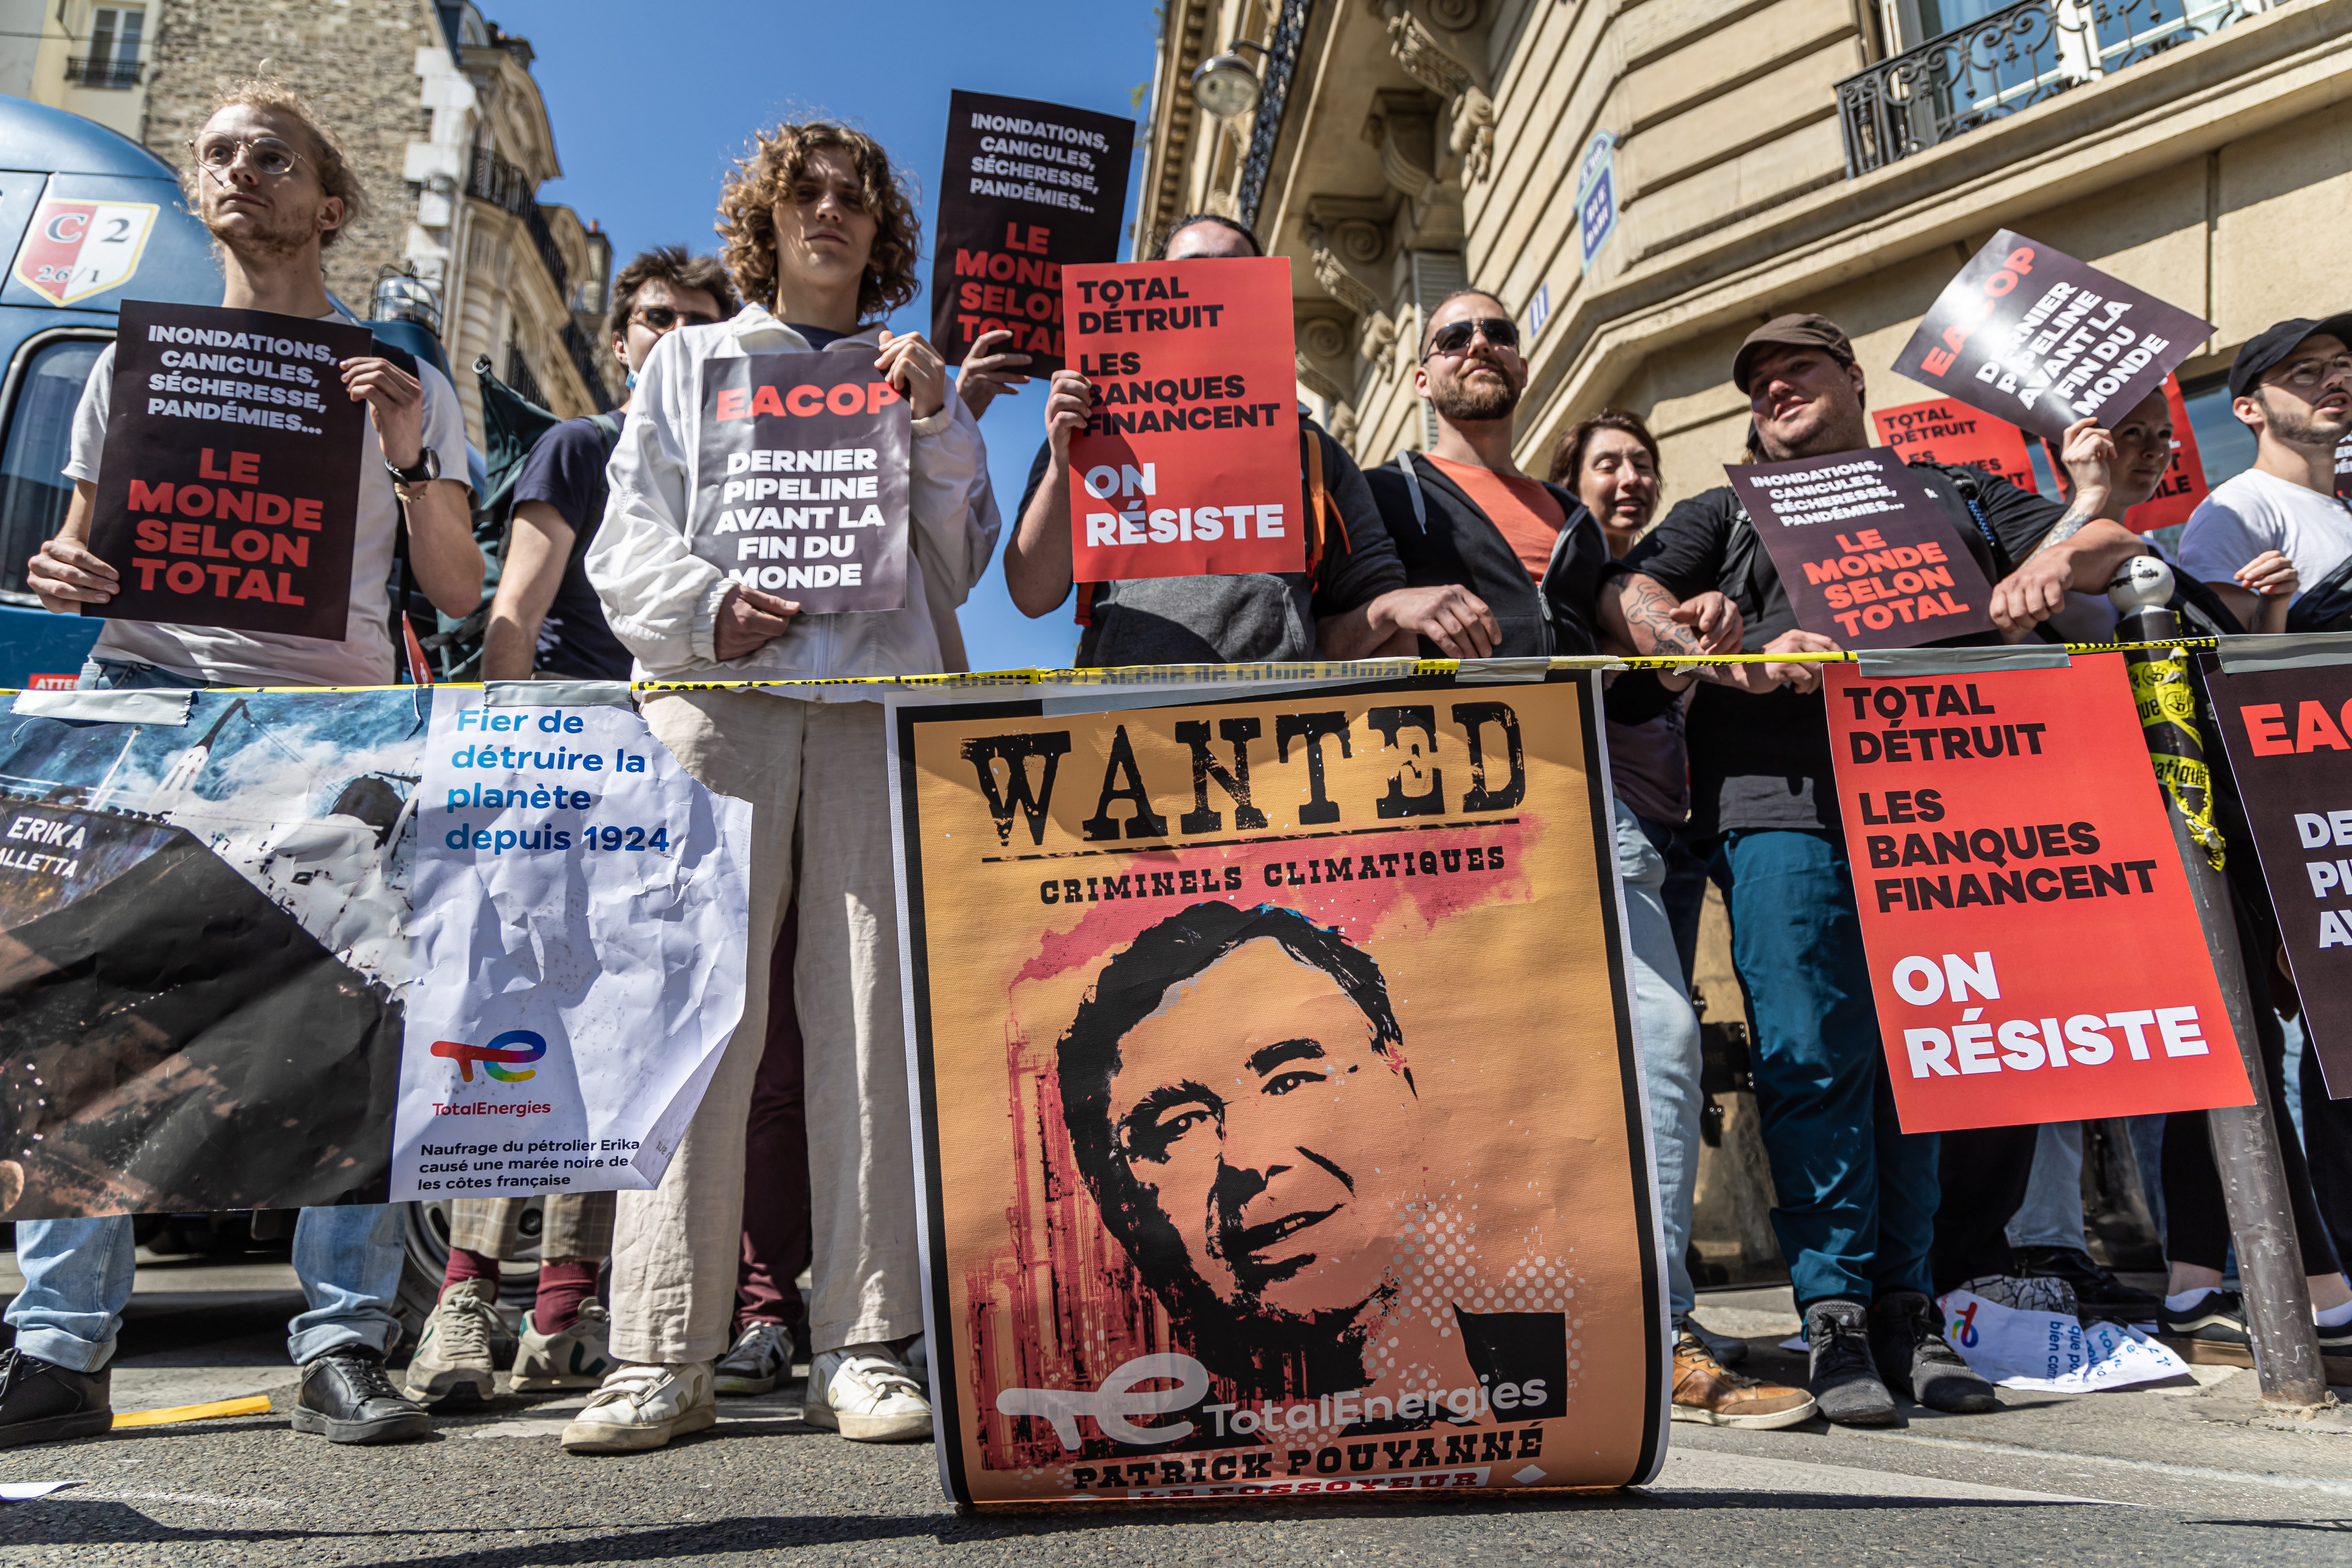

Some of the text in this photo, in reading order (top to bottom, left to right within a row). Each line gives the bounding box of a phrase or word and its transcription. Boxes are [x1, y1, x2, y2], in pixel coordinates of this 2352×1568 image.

[971, 113, 1109, 153] INONDATIONS,
[980, 136, 1096, 172] CANICULES,
[971, 154, 1099, 194] SÉCHERESSE,
[970, 178, 1094, 214] PANDÉMIES...
[101, 218, 130, 243] 2
[1005, 221, 1050, 256] LE
[955, 248, 1062, 290] MOND
[1077, 276, 1189, 303] TOTAL
[1079, 303, 1223, 334] DÉTRUIT
[1975, 281, 2078, 384] DERNIER
[148, 325, 338, 366] INONDATIONS,
[1996, 290, 2103, 394] PIPELINE
[2017, 301, 2133, 410] AVANT LA
[161, 350, 319, 387] CANICULES,
[1080, 352, 1140, 376] LES
[2052, 325, 2136, 399] FIN DU
[2071, 333, 2170, 416] MONDE
[149, 370, 327, 414] SÉCHERESSE,
[716, 383, 900, 421] EACOP
[1089, 374, 1245, 407] BANQUES
[148, 398, 322, 434] PANDÉMIES...
[1083, 403, 1280, 436] FINANCENT
[1883, 406, 1954, 429] TOTAL
[1889, 420, 1976, 446] DÉTRUIT
[199, 448, 261, 485] LE
[727, 448, 877, 475] DERNIER
[1749, 460, 1883, 488] INONDATIONS,
[723, 475, 878, 505] PIPELINE
[1084, 462, 1156, 499] ON
[1769, 474, 1881, 499] CANICULES,
[127, 480, 323, 531] MONDE
[1770, 485, 1897, 514] SÉCHERESSE,
[1779, 500, 1905, 527] PANDÉMIES...
[713, 504, 885, 535] AVANT LA
[1086, 500, 1285, 547] RÉSISTE
[134, 519, 310, 568] SELON
[737, 534, 855, 561] FIN DU
[1835, 528, 1887, 553] LE
[728, 563, 862, 590] MONDE
[1802, 541, 1948, 585] MONDE
[132, 557, 305, 606] TOTAL
[1824, 565, 1955, 609] SELON
[1833, 591, 1970, 637] TOTAL
[1843, 684, 1994, 720] TOTAL
[457, 709, 584, 734] Fier de
[452, 744, 645, 773] détruire la
[1848, 719, 2046, 764] DÉTRUIT
[960, 701, 1526, 848] WANTED
[446, 783, 591, 814] planète
[1859, 788, 1945, 826] LES
[7, 817, 86, 850] ERIKA
[445, 823, 670, 855] depuis 1924
[1866, 821, 2101, 869] BANQUES
[1040, 844, 1506, 905] CRIMINELS CLIMATIQUES
[1874, 860, 2157, 913] FINANCENT
[1892, 951, 2001, 1006] ON
[1903, 1005, 2210, 1079] RÉSISTE
[432, 1100, 551, 1118] TotalEnergies
[419, 1156, 628, 1173] causé une marée noire de
[421, 1139, 640, 1157] Naufrage du pétrolier Erika
[418, 1174, 571, 1191] les côtes française
[2049, 1321, 2064, 1351] bien
[2068, 1325, 2082, 1350] que
[1203, 1373, 1548, 1437] TotalEnergies
[1073, 1422, 1543, 1490] PATRICK POUYANNÉ
[1209, 1472, 1478, 1496] FOSSOYEUR
